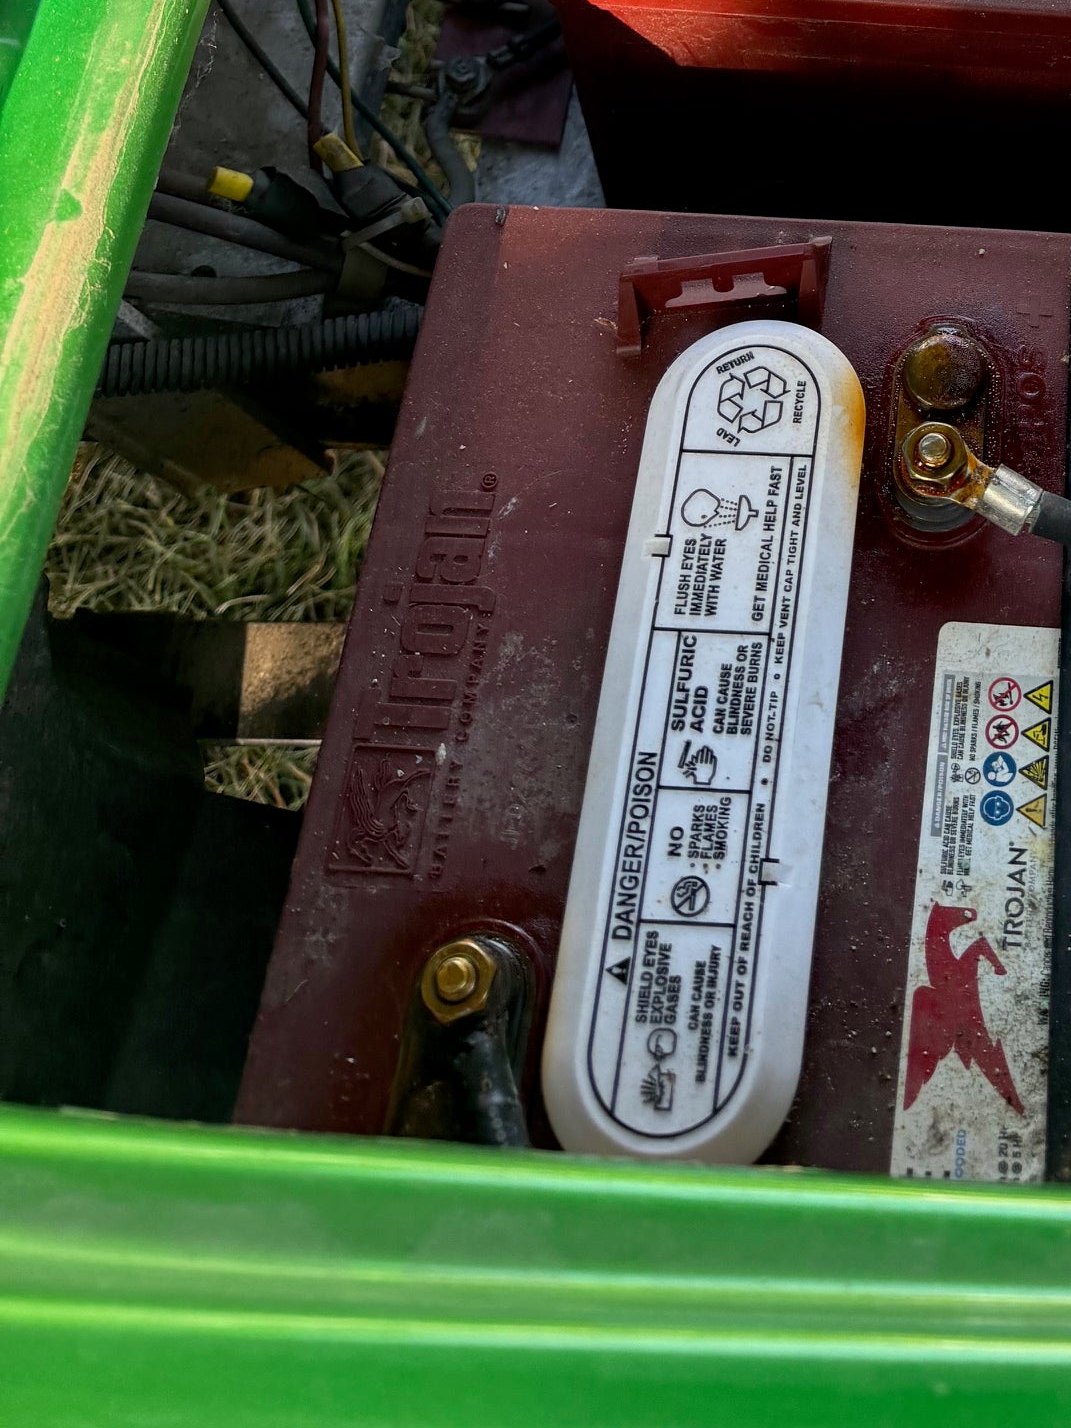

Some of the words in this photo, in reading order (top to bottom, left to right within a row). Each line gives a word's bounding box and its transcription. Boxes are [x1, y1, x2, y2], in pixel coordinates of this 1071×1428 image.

[715, 349, 756, 375] RETURN
[792, 380, 807, 424] RECYCLE
[715, 426, 741, 446] LEAD
[766, 465, 782, 496] FAST
[794, 464, 807, 500] LEVEL
[762, 499, 778, 531] HELP
[791, 502, 802, 527] AND
[680, 538, 697, 570] EYES
[708, 538, 727, 581] WATER
[754, 534, 773, 591] MEDICAL
[786, 529, 799, 565] TIGHT
[688, 532, 712, 616] IMMEDIATELY
[783, 568, 793, 593] CAP
[673, 573, 691, 615] FLUSH
[704, 586, 720, 616] WITH
[750, 594, 766, 622] GET
[778, 595, 791, 628] VENT
[735, 644, 748, 662] OR
[746, 641, 762, 683] BURNS
[773, 632, 785, 664] KEEP
[456, 622, 491, 743] COMPANY
[670, 635, 697, 732] SULFURIC
[715, 663, 732, 705] CAUSE
[726, 665, 745, 735] BLINDNESS
[767, 690, 778, 711] TIP
[689, 685, 708, 733] ACID
[712, 707, 726, 734] CAN
[740, 686, 757, 735] SEVERE
[764, 715, 775, 741] NOT
[761, 744, 773, 763] DO
[610, 751, 658, 941] DANGER/POISON
[666, 825, 684, 857] NO
[686, 804, 705, 858] SPARKS
[699, 804, 718, 859] FLAMES
[712, 796, 732, 860] SMOKING
[748, 802, 765, 874] CHILDREN
[745, 878, 759, 897] OF
[739, 900, 754, 951] REACH
[641, 930, 659, 967] EYES
[735, 955, 748, 976] OF
[634, 970, 653, 1023] SHIELD
[649, 943, 671, 1024] EXPLOSIVE
[663, 975, 681, 1025] GASES
[731, 979, 745, 1011] OUT
[727, 1016, 740, 1057] KEEP
